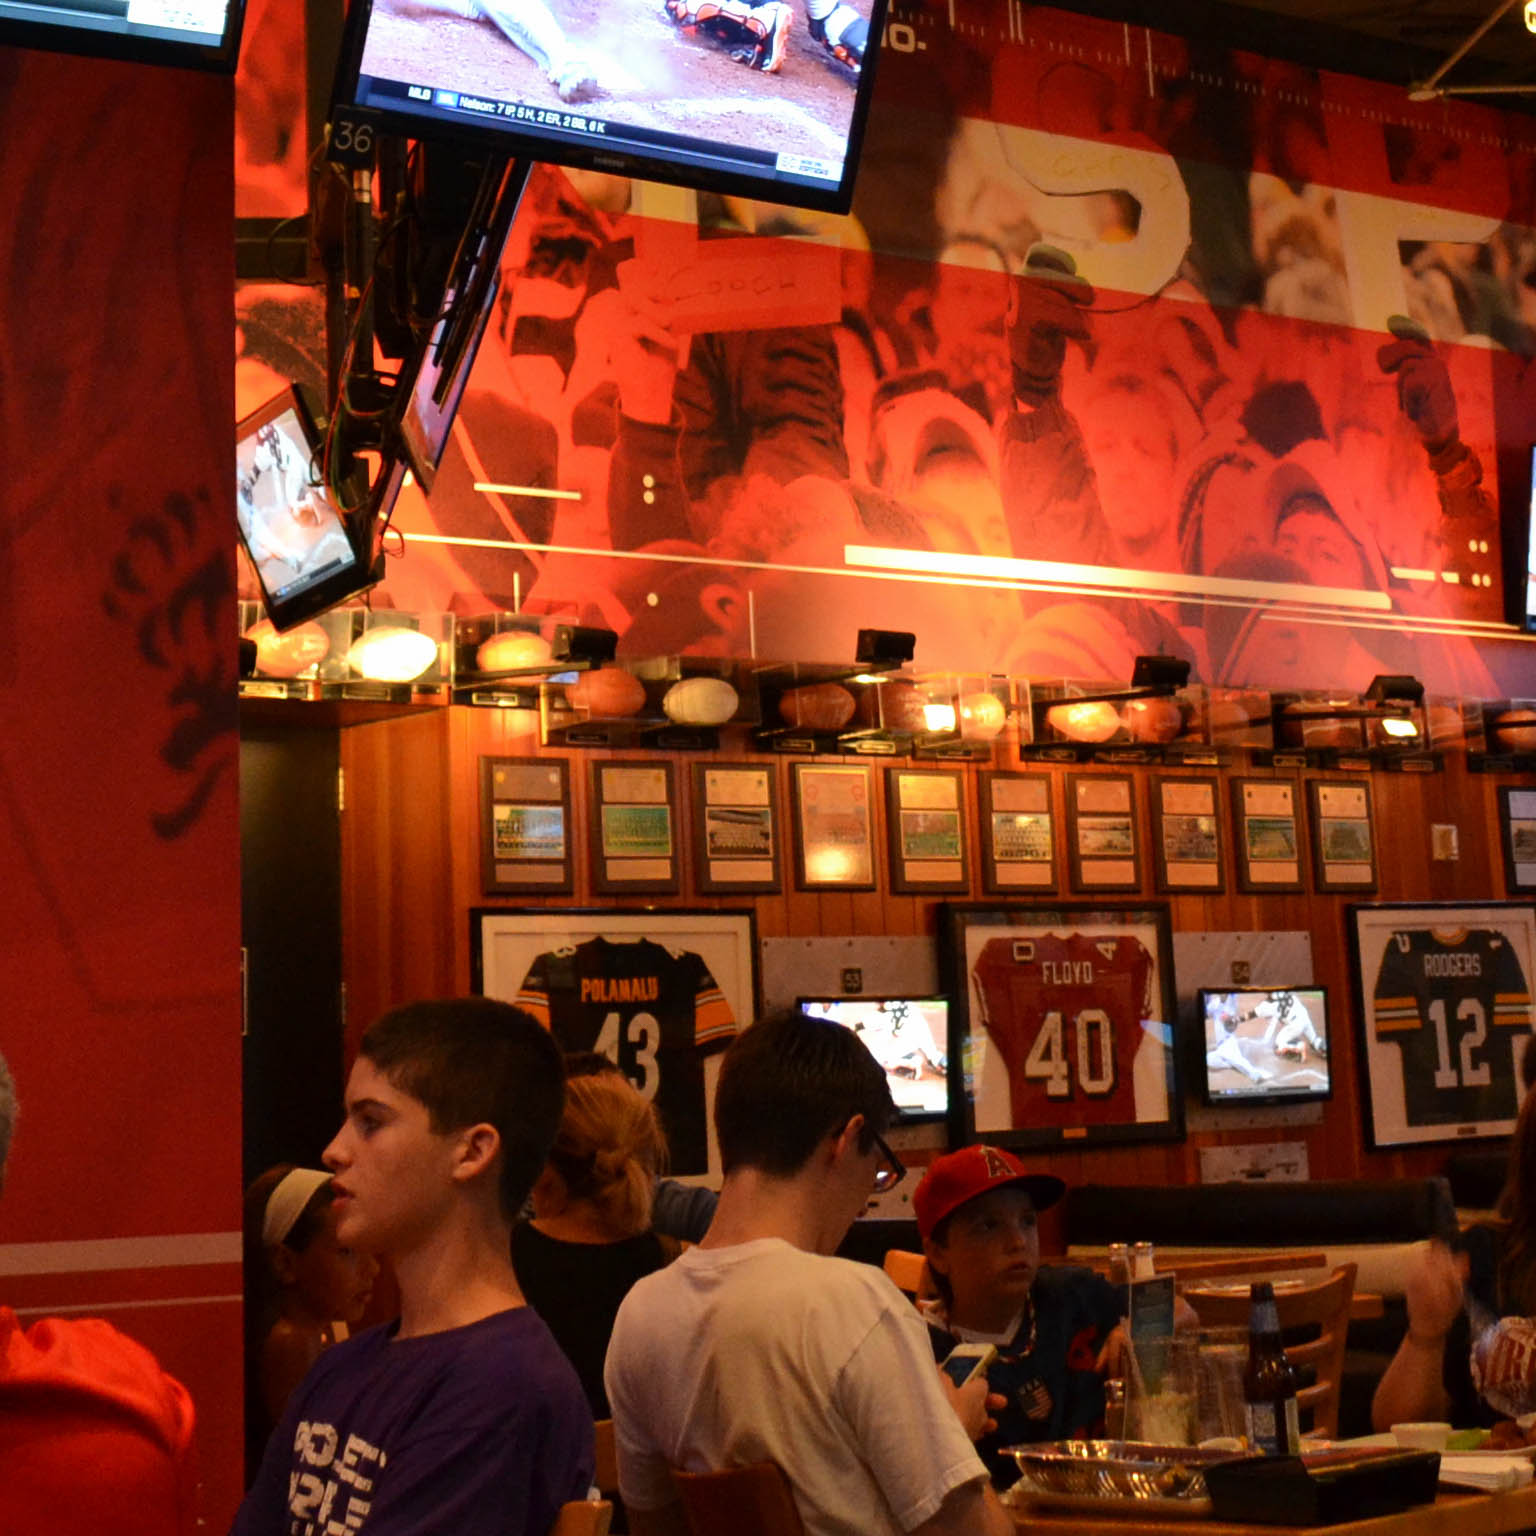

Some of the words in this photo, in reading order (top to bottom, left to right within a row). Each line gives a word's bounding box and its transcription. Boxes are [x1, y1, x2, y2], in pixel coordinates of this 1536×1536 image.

[408, 86, 431, 101] MLB
[497, 103, 505, 114] 7
[596, 121, 606, 133] K
[335, 120, 373, 153] 36
[1042, 960, 1094, 985] FLOYD
[1424, 952, 1483, 978] RODGERS
[580, 976, 661, 1004] POLAMALU
[1024, 1008, 1115, 1097] 40
[1428, 997, 1492, 1089] 12
[979, 1144, 1017, 1178] A
